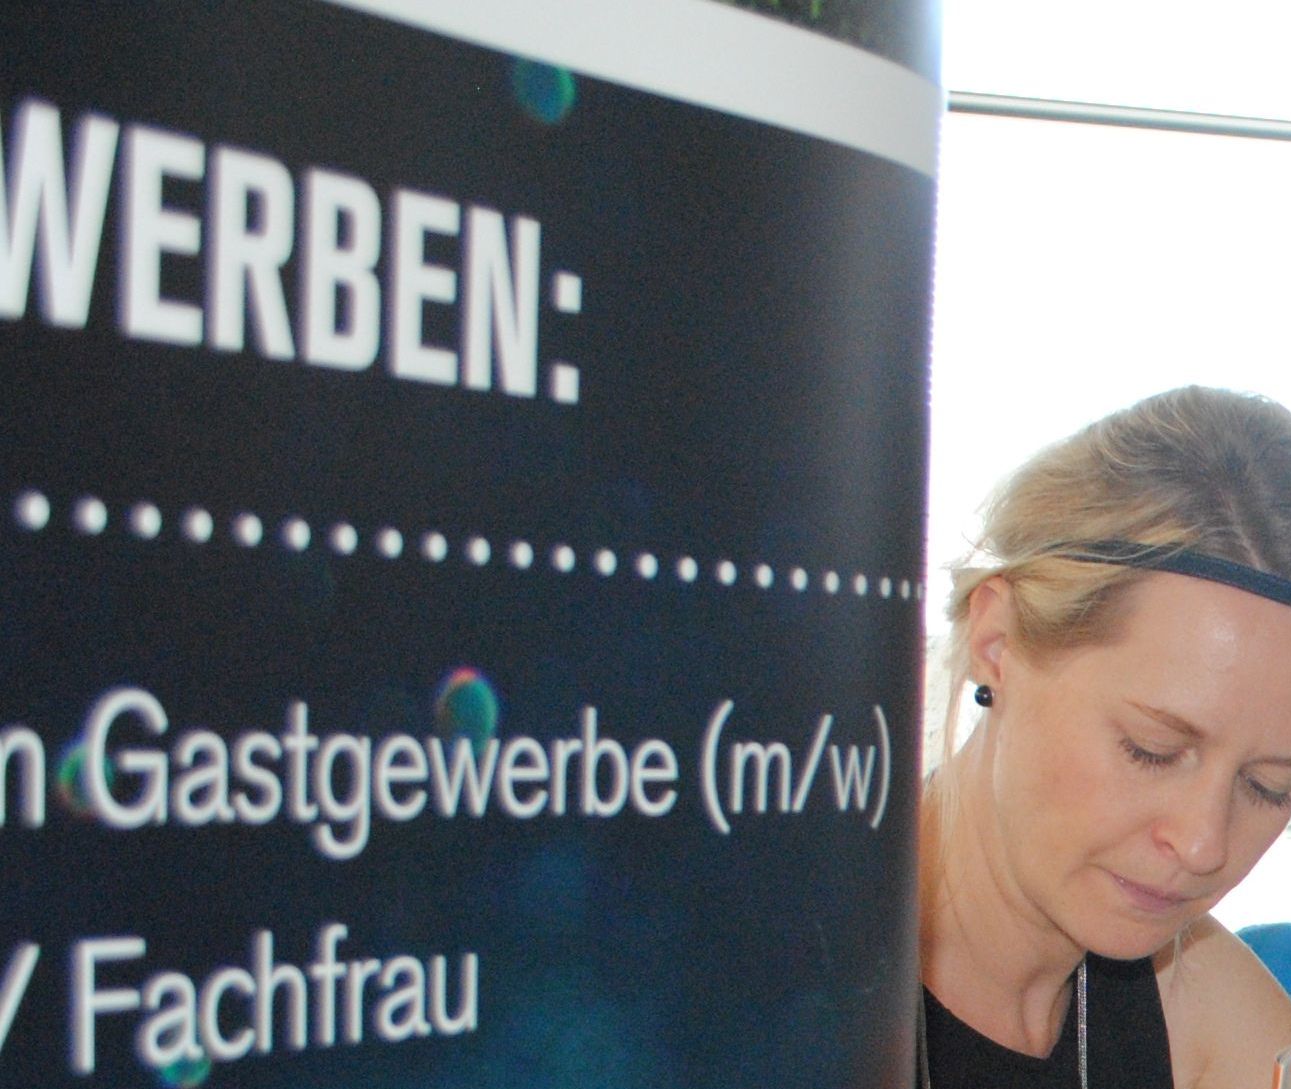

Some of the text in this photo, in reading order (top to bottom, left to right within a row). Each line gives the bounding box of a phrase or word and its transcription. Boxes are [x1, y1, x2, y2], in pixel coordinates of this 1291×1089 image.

[86, 686, 680, 860] Gastgewerbe
[701, 699, 892, 834] (m/w)
[70, 923, 480, 1076] Fachfrau
